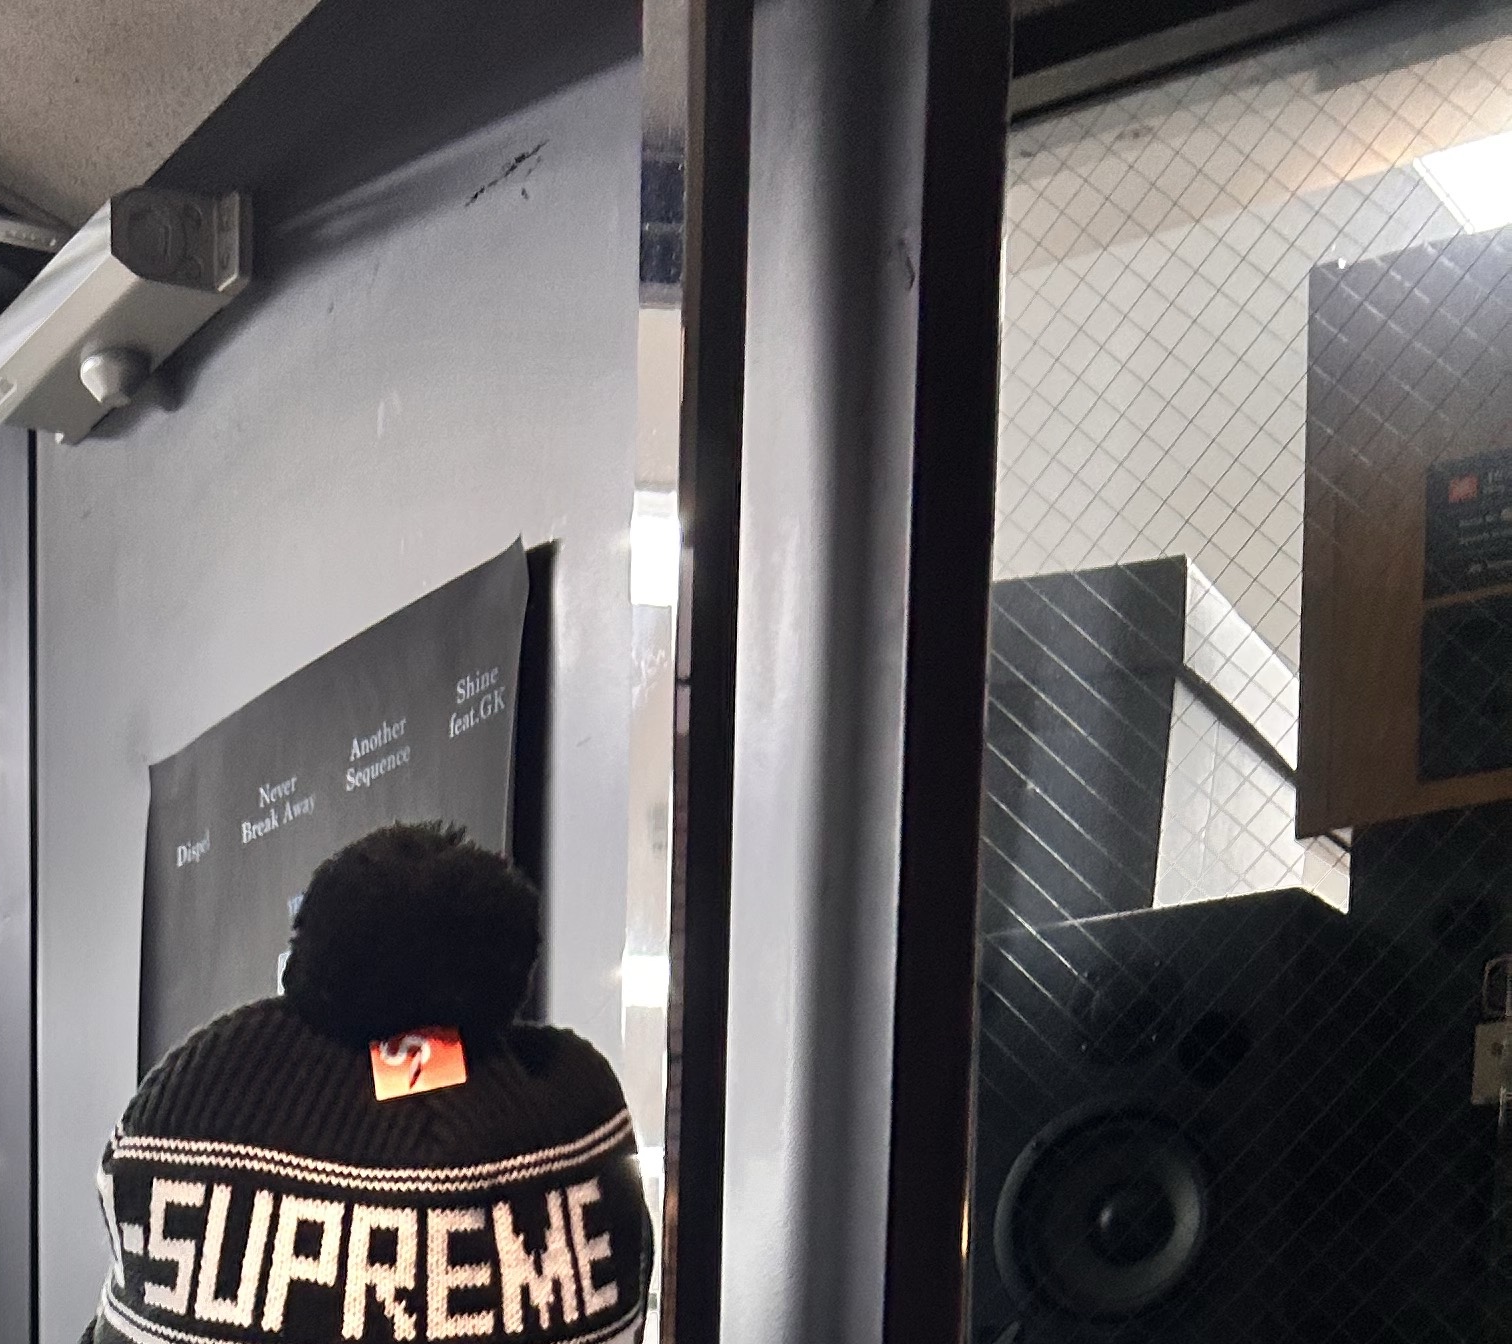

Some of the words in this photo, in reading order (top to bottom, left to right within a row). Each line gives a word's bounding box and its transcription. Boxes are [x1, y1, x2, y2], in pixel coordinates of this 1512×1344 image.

[456, 667, 499, 704] Shine
[449, 686, 506, 739] feat.GK
[349, 717, 407, 762] Another
[259, 776, 298, 808] Never
[345, 745, 411, 792] Sequence
[241, 808, 280, 844] Break
[282, 794, 316, 825] Away
[142, 1177, 619, 1341] SUPREME
